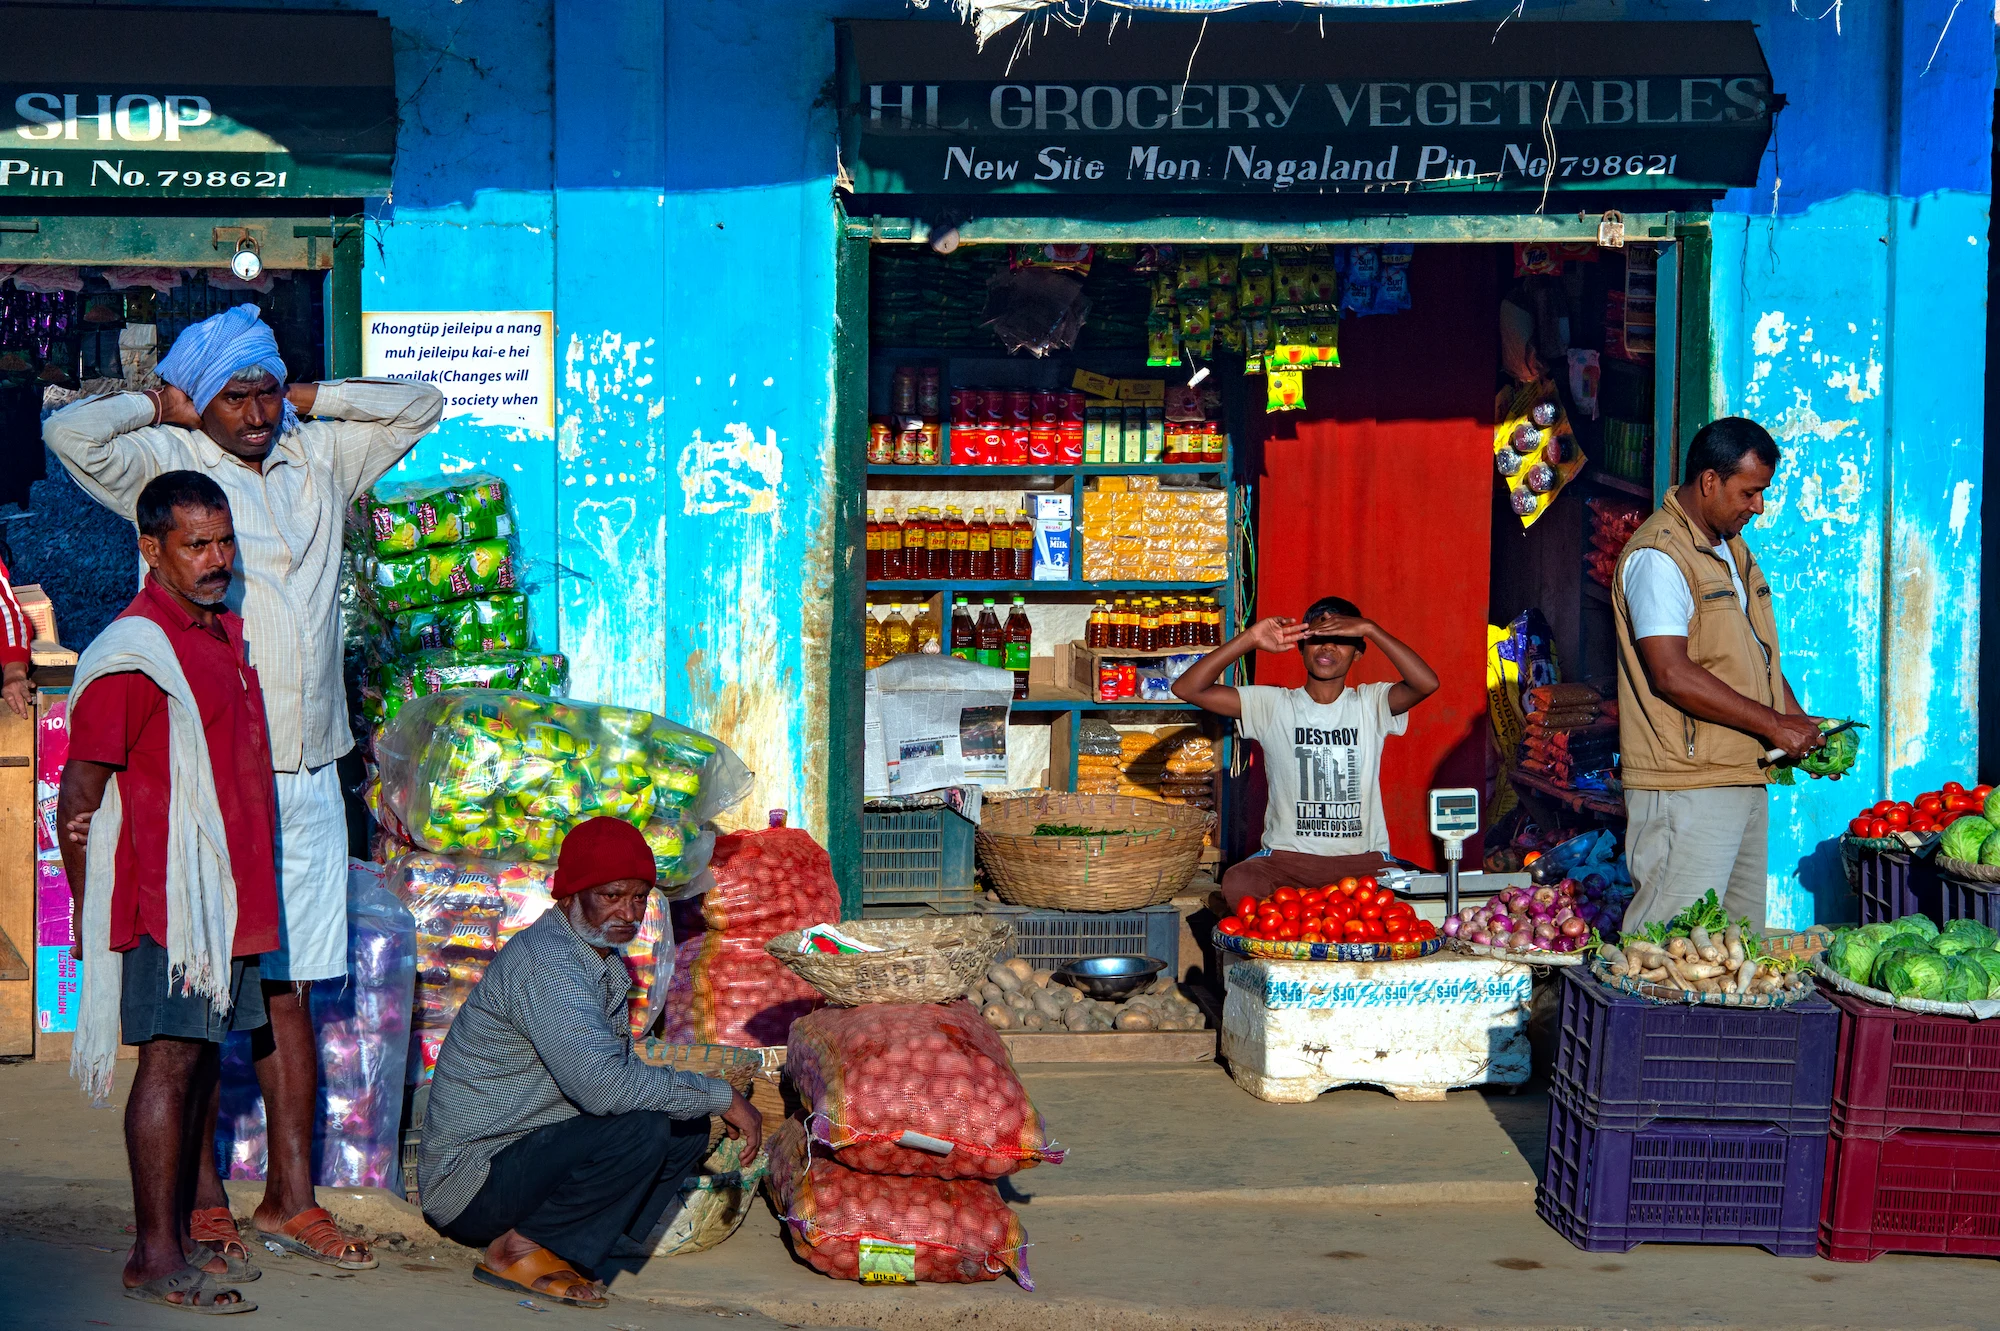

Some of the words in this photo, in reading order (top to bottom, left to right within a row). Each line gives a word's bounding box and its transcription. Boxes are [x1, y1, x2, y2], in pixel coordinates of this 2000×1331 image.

[989, 83, 1305, 132] GROCERY
[1326, 78, 1768, 127] VEGETABLES
[15, 92, 211, 142] SHOP
[0, 159, 64, 187] Pin
[91, 159, 151, 188] No.
[157, 171, 288, 188] 798621
[943, 145, 1018, 181] New
[1034, 146, 1105, 181] Site
[1223, 145, 1398, 188] Nagaland
[1416, 145, 1477, 180] Pin
[1559, 154, 1677, 178] 798621
[1526, 249, 1548, 266] Tide
[371, 322, 440, 337] Khongtüp
[441, 322, 493, 337] jeileipu
[495, 324, 504, 334] a
[507, 323, 542, 337] nang
[385, 347, 416, 359] muh
[417, 346, 470, 361] jeileipu
[472, 346, 506, 358] kai-e
[508, 345, 530, 358] hei
[505, 369, 529, 382] will
[451, 393, 500, 408] society
[502, 393, 538, 406] when
[1049, 540, 1068, 549] Milk
[1294, 727, 1359, 746] DESTROY
[1297, 803, 1323, 818] THE
[1325, 803, 1361, 819] MOOD
[1297, 819, 1330, 831] BANQUET
[58, 949, 67, 978] MASTI
[68, 949, 77, 978] SAAT
[68, 981, 77, 993] KE
[1332, 987, 1355, 1001] DFS
[1385, 985, 1407, 1000] DFS
[1437, 985, 1459, 998] DFS
[1487, 982, 1510, 996] DFS
[873, 1273, 897, 1281] Utkal
